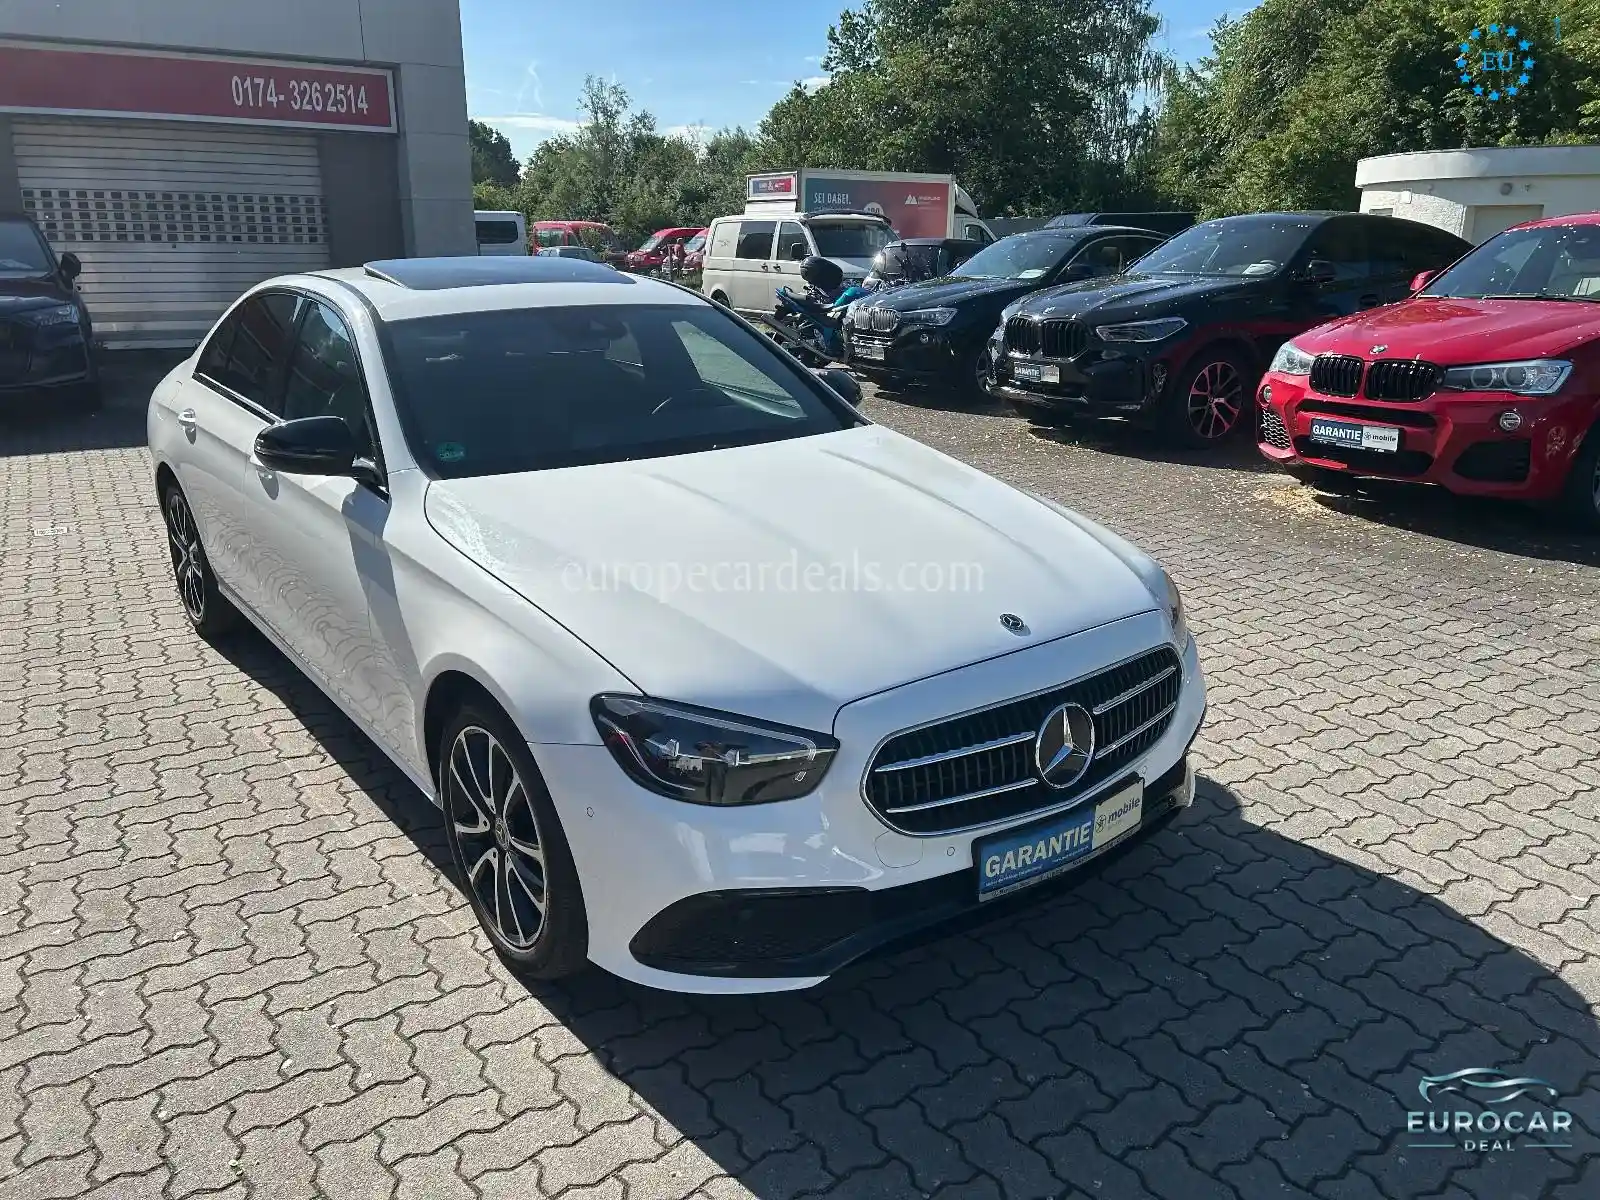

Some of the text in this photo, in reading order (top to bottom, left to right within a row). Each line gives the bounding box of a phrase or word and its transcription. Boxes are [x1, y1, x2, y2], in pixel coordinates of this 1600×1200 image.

[231, 75, 285, 108] 0174-
[1312, 424, 1397, 442] GARANTIE mobile
[985, 821, 1092, 878] GARANTIE
[1107, 797, 1141, 825] mobile
